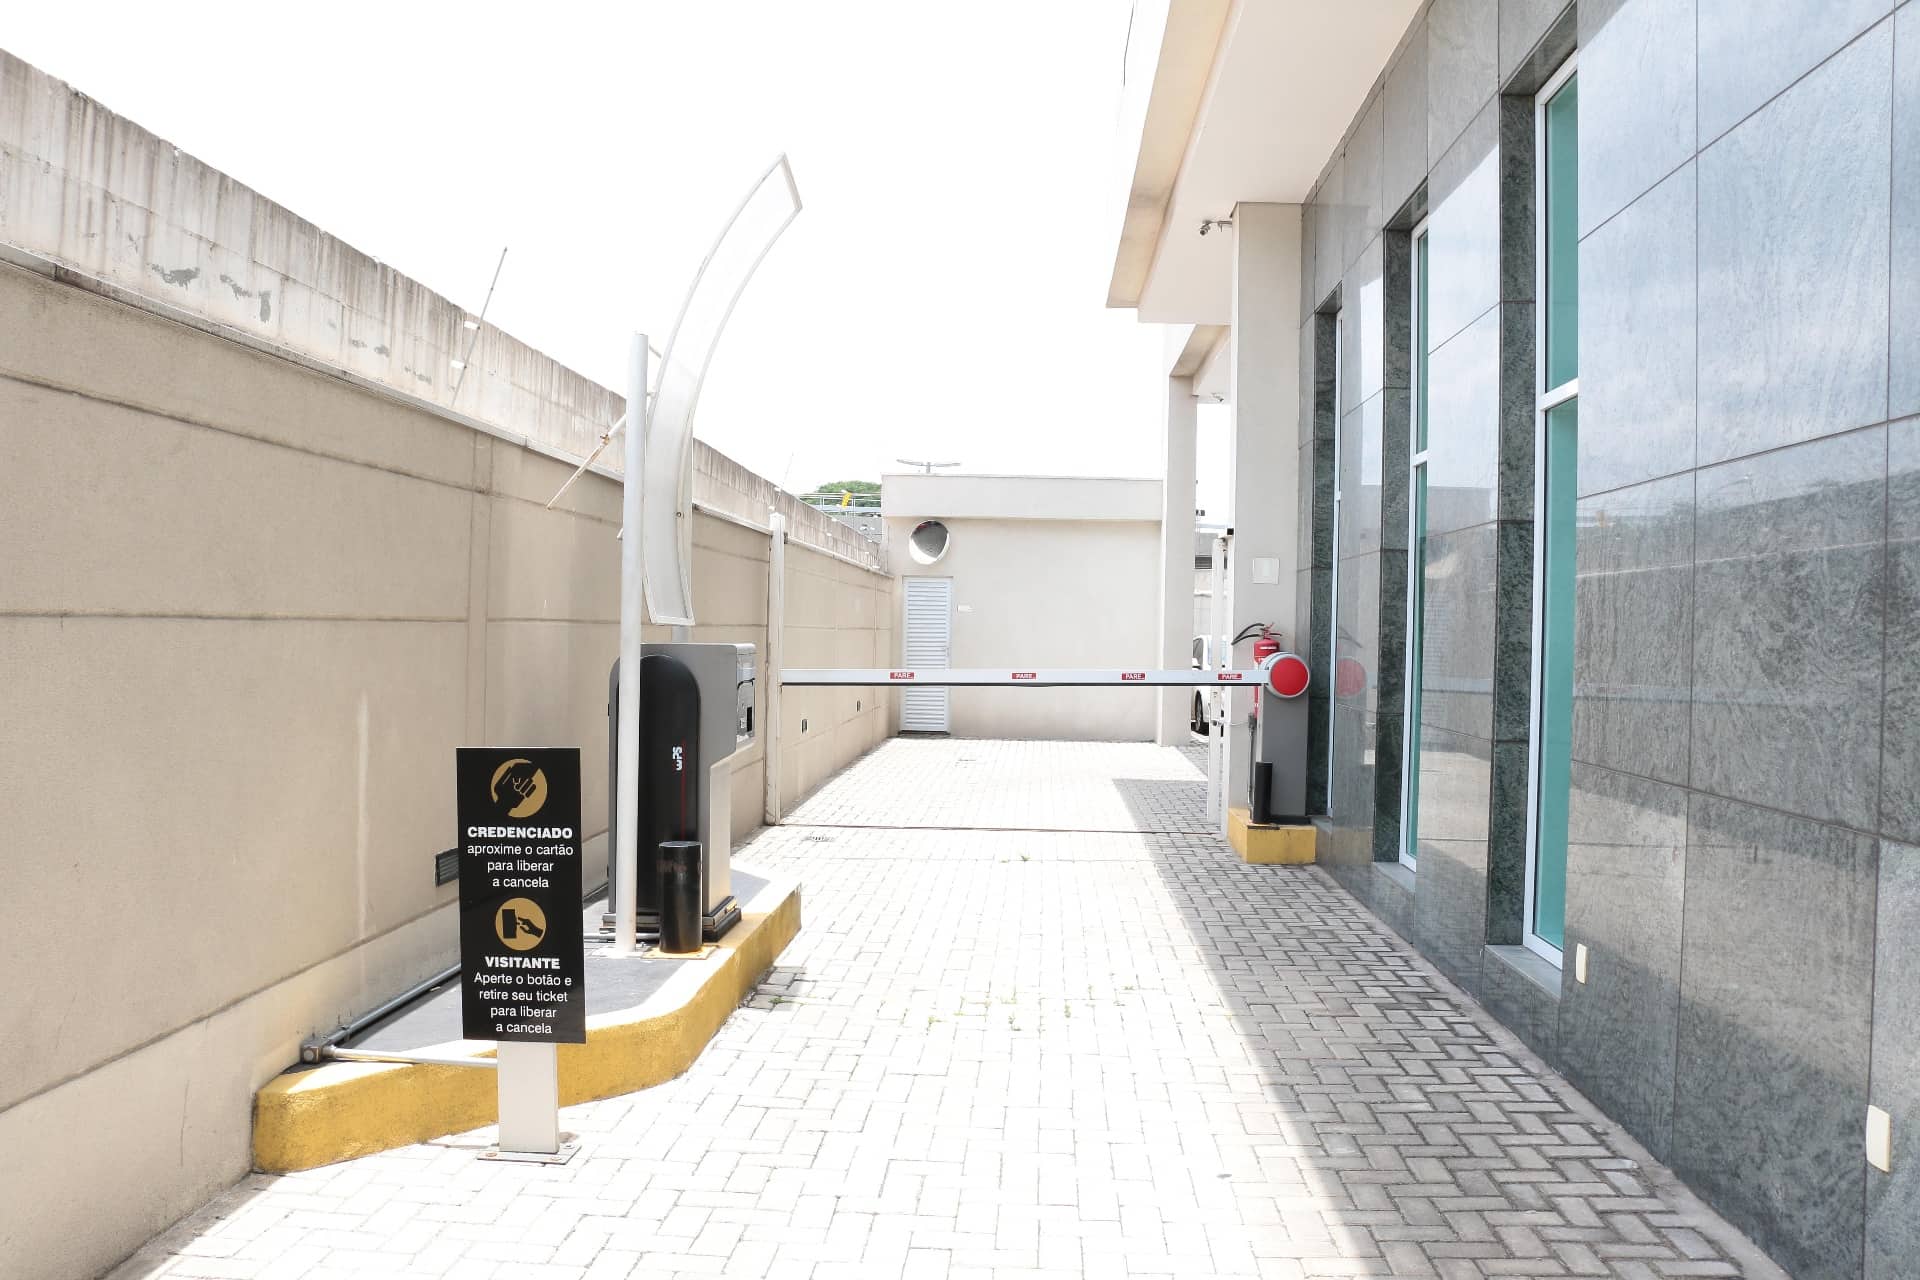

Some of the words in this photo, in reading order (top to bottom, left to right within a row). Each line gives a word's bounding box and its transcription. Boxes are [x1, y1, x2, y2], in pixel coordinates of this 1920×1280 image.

[467, 826, 573, 839] CREDENCIADO
[467, 844, 522, 857] aproxime
[524, 847, 533, 856] o
[536, 844, 574, 857] cartão
[487, 862, 514, 873] para
[516, 860, 554, 873] liberar
[492, 878, 500, 887] a
[503, 876, 549, 888] cancela
[484, 956, 561, 970] VISITANTE
[473, 973, 513, 986] Aperte
[515, 976, 524, 985] o
[527, 974, 562, 987] botão
[563, 977, 572, 987] e
[479, 989, 508, 1001] retire
[511, 991, 533, 1002] seu
[536, 990, 569, 1003] ticket
[491, 1007, 517, 1019] para
[519, 1005, 557, 1018] liberar
[495, 1024, 503, 1033] a
[506, 1022, 552, 1035] cancela
